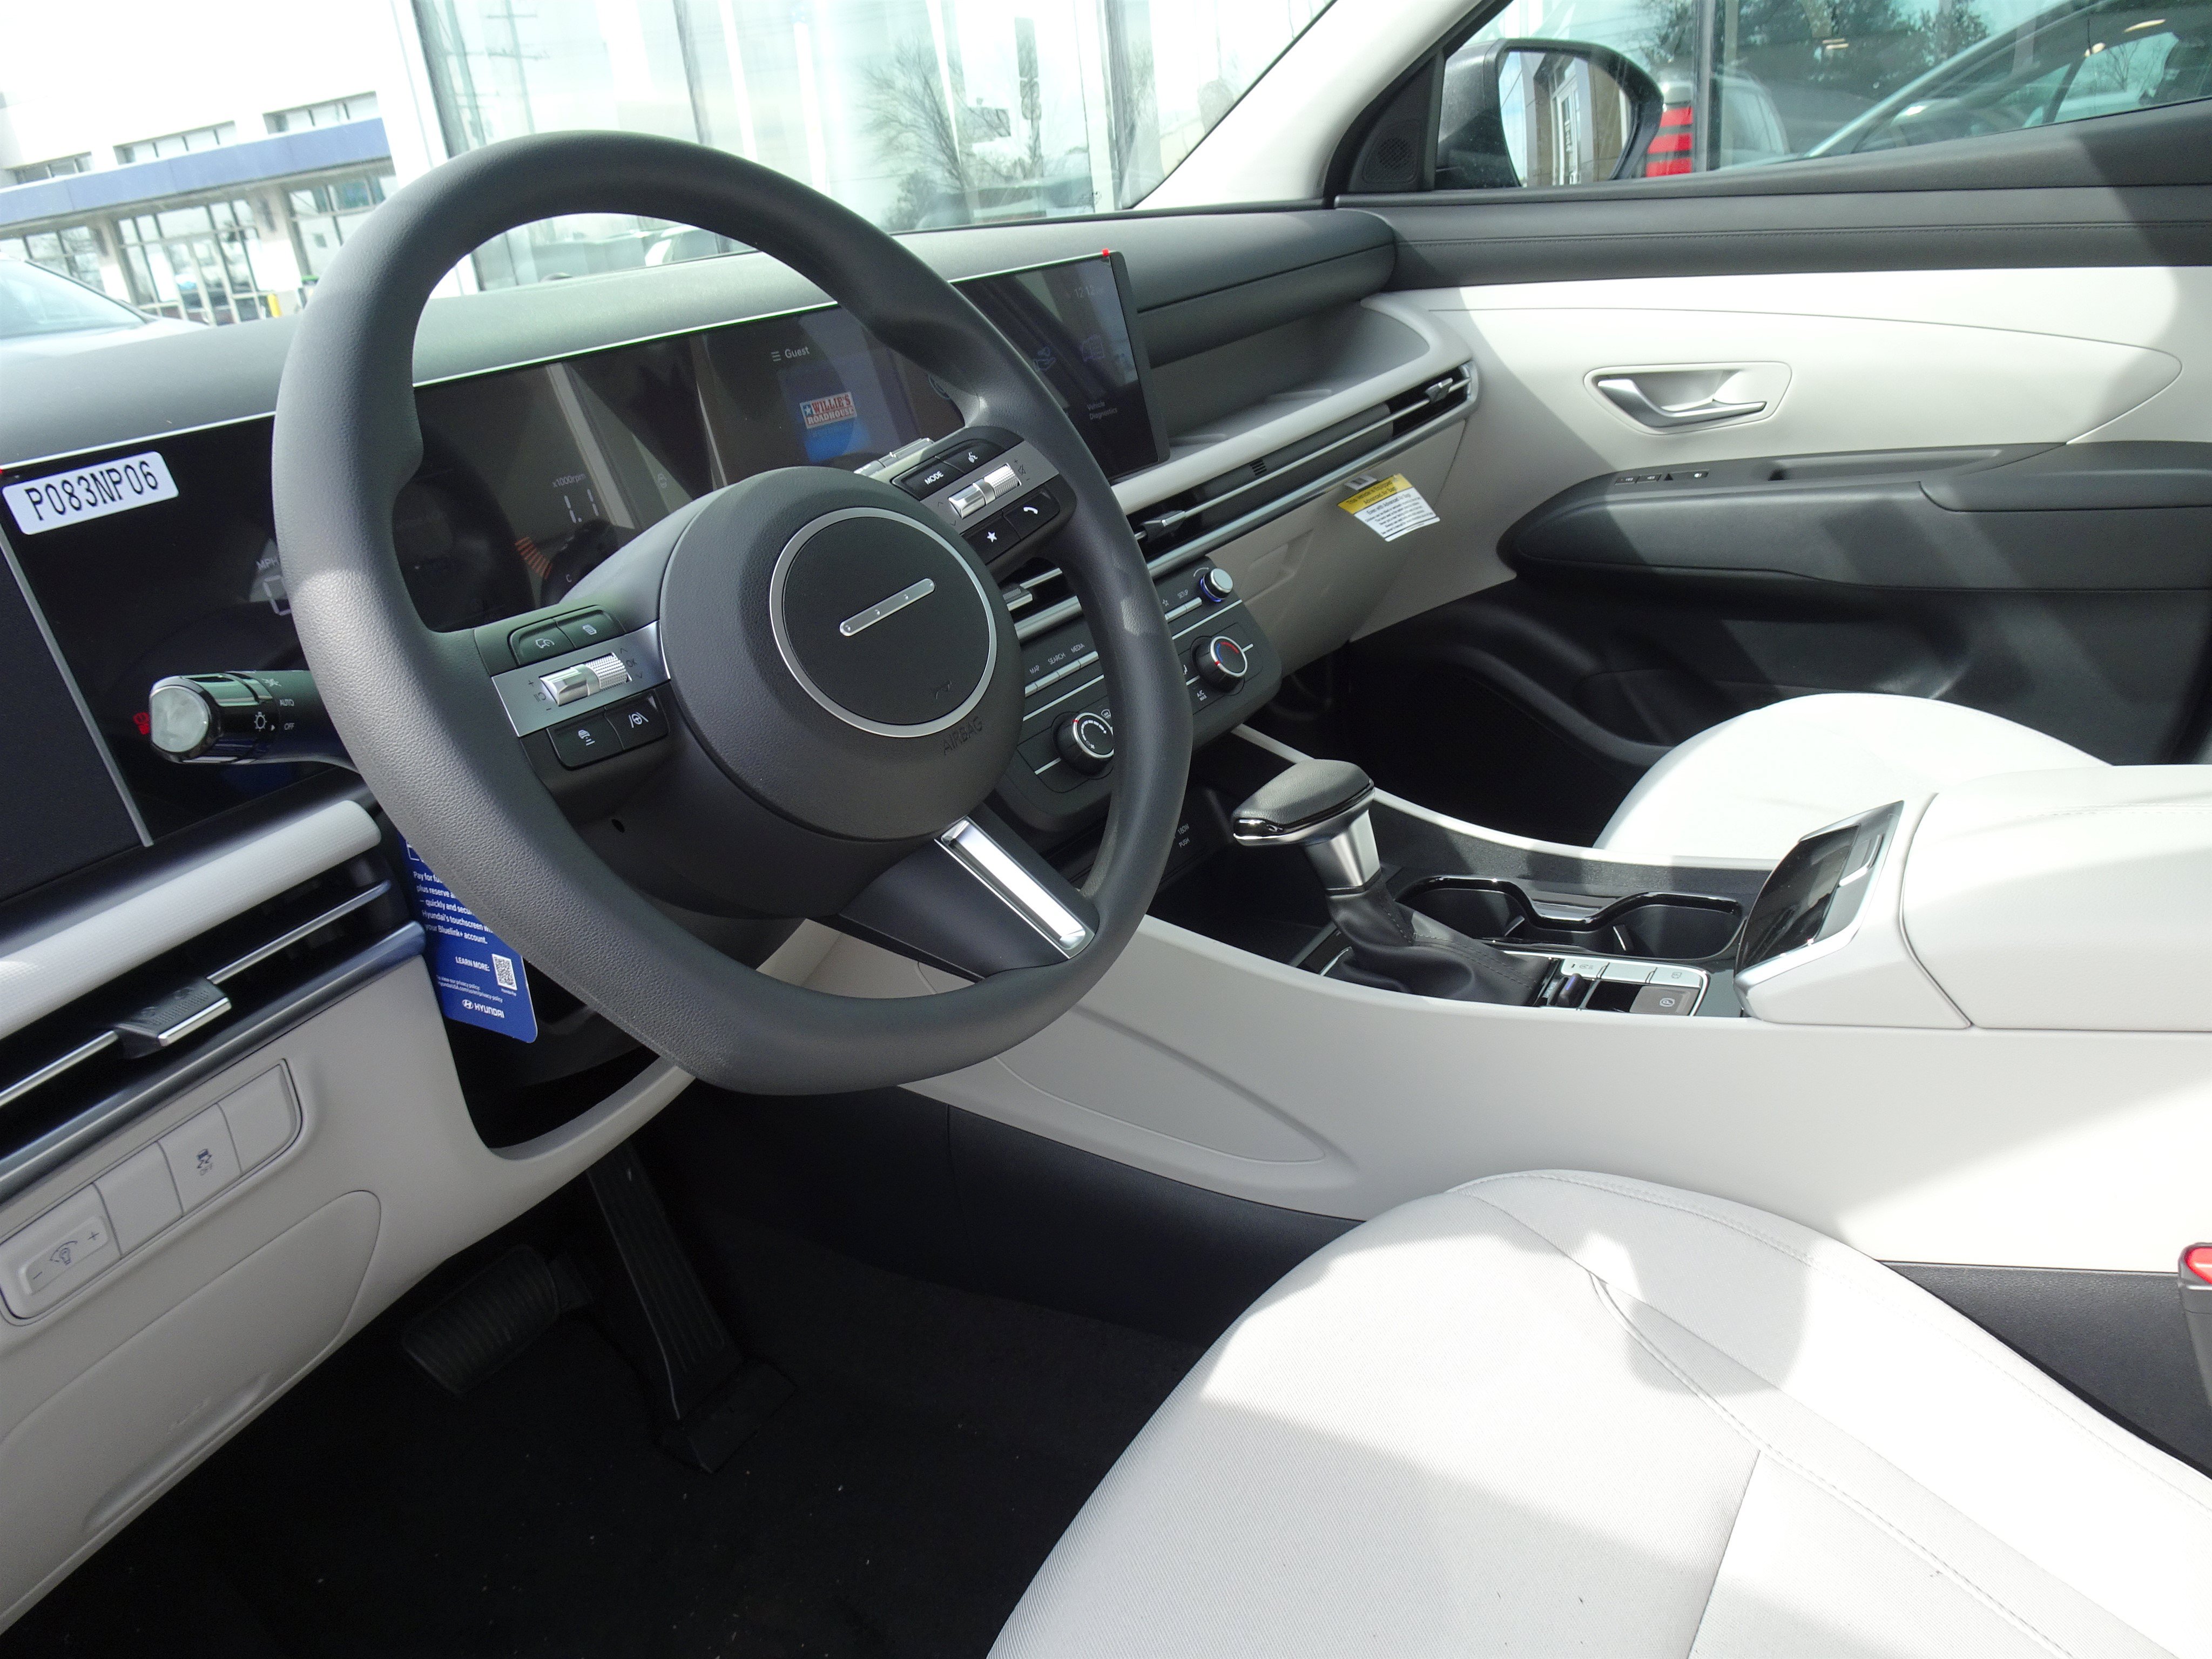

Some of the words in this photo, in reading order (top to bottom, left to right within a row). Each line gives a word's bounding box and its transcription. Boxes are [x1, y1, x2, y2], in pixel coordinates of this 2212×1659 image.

[785, 346, 810, 359] Guest
[811, 394, 851, 414] WILLIE'S
[806, 406, 855, 426] ROADHOUSE
[1089, 408, 1118, 420] Diagnostics
[552, 473, 586, 488] x1000rpm
[924, 471, 944, 485] MODE
[24, 461, 158, 521] P083NP06
[626, 658, 637, 668] OK
[1029, 665, 1040, 675] MAP
[1048, 652, 1066, 665] SEARCH
[1070, 643, 1085, 653] MEDIA
[944, 717, 983, 756] AIRBAG
[413, 871, 423, 881] Pay
[424, 873, 433, 881] for
[416, 885, 429, 893] plus
[429, 888, 450, 898] reserve
[426, 899, 446, 911] quickly
[422, 910, 450, 922] Hyundai's
[449, 916, 484, 930] touchscreen
[464, 933, 488, 944] account.
[455, 956, 473, 967] LEARN
[473, 960, 490, 972] MORE:
[475, 1003, 505, 1019] HYUNDAI
